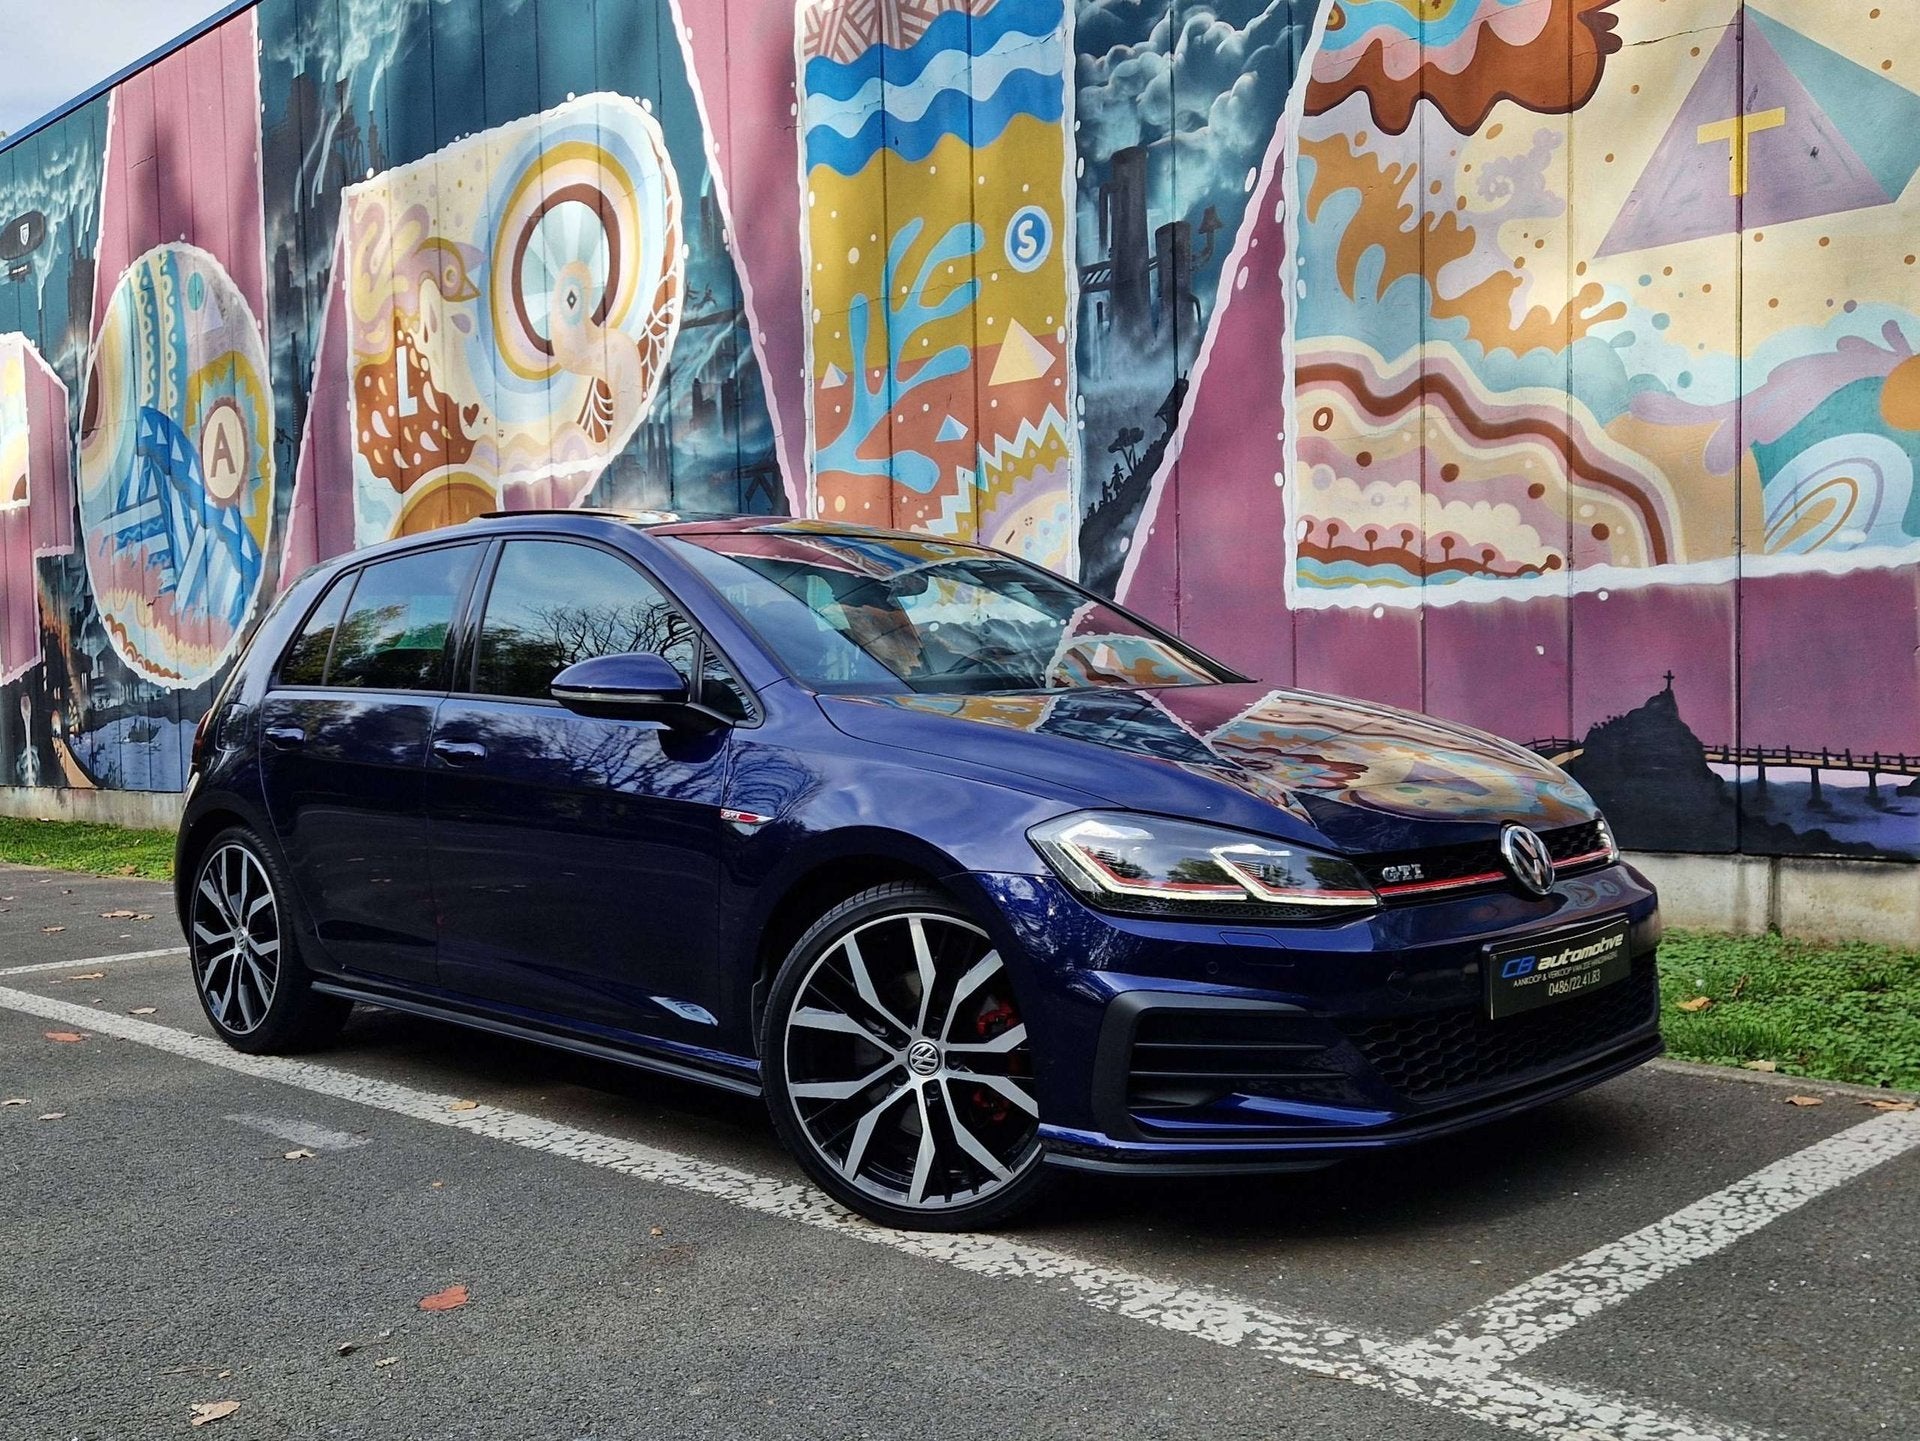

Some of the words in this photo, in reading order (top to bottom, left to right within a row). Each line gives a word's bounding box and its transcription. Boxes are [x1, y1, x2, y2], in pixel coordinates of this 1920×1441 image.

[1017, 219, 1037, 259] S
[396, 345, 418, 417] L
[210, 422, 236, 478] A
[1382, 863, 1424, 883] GTI
[1502, 955, 1536, 978] CB
[1538, 933, 1624, 970] automotive
